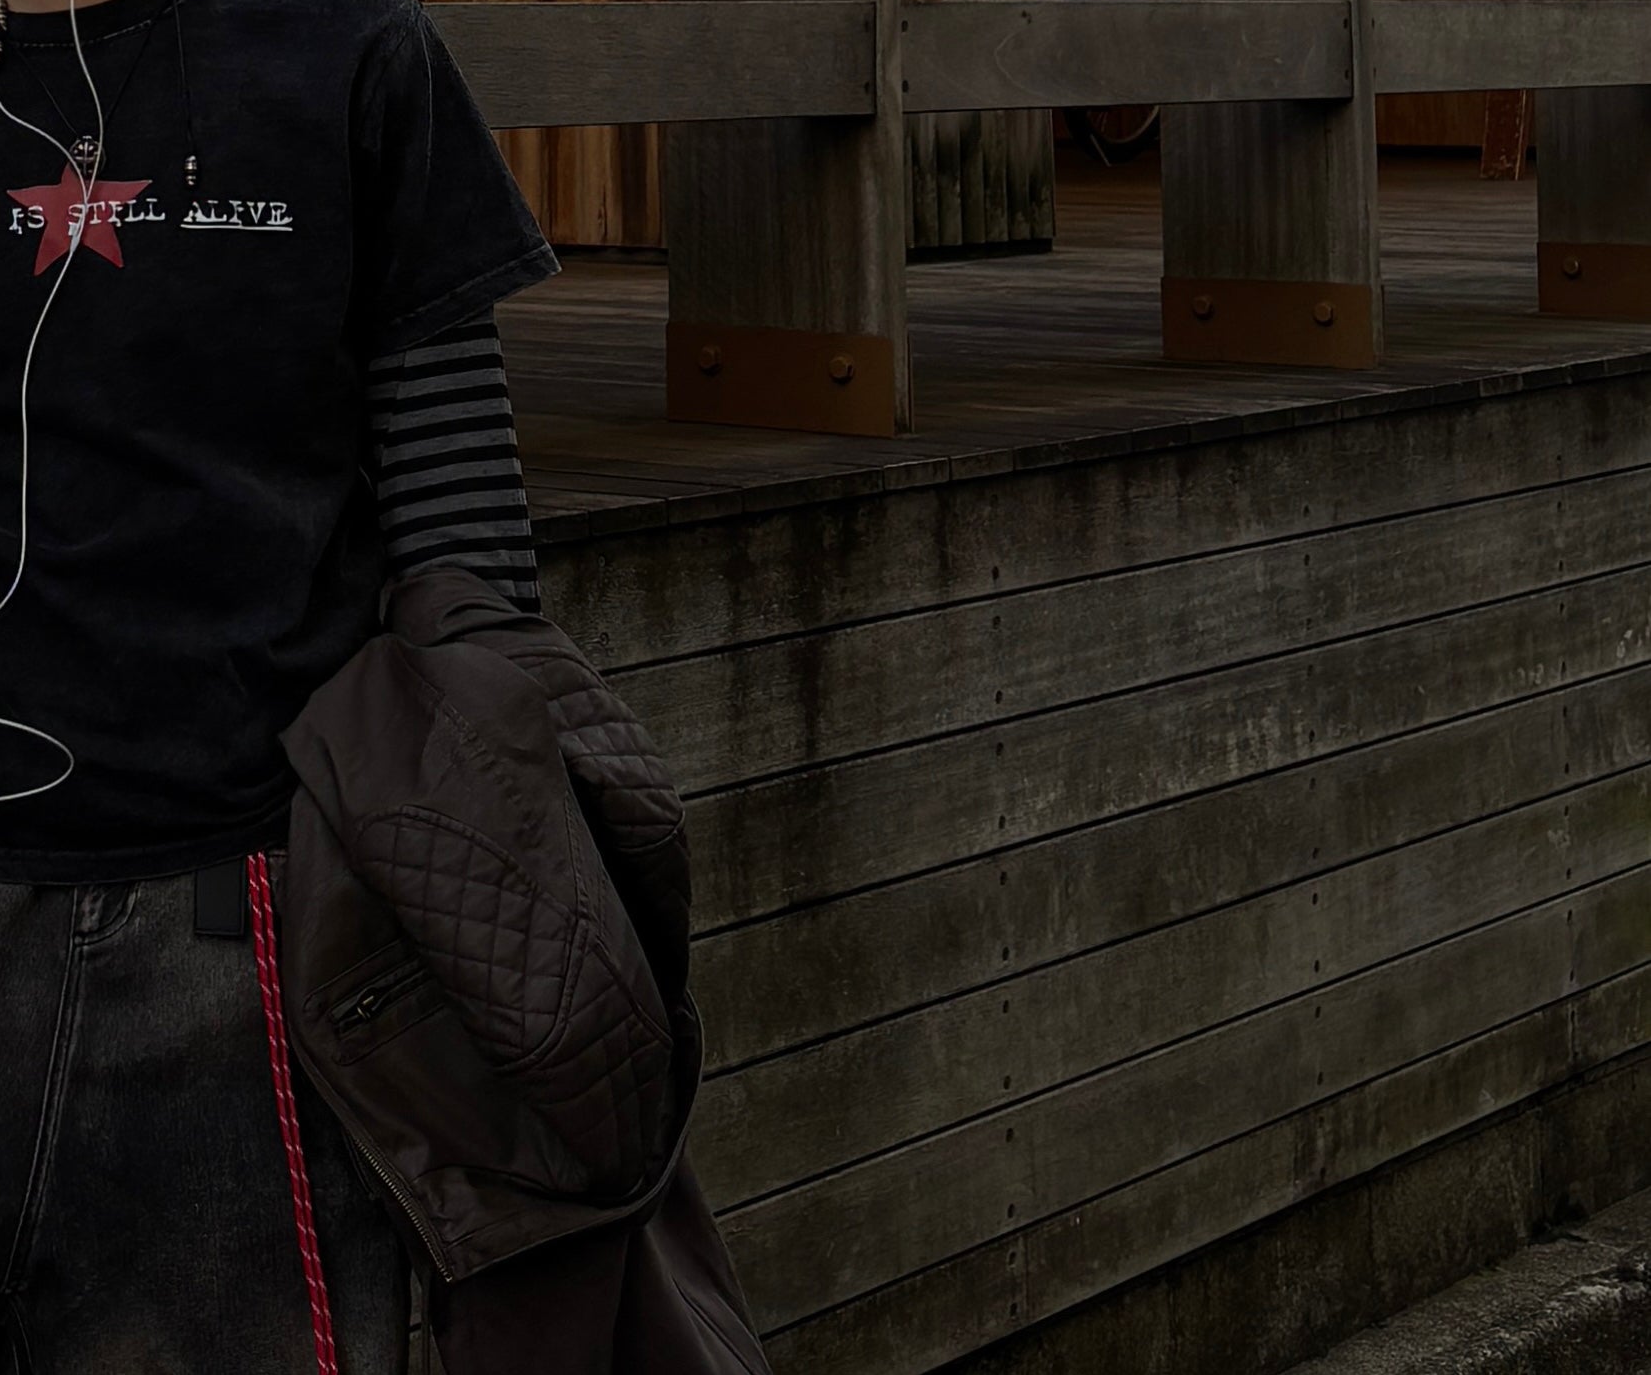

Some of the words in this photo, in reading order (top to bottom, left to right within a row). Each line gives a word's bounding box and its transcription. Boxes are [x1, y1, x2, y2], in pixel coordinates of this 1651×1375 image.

[9, 205, 45, 235] IS
[68, 198, 165, 227] STILL
[183, 200, 293, 225] ALIVE
